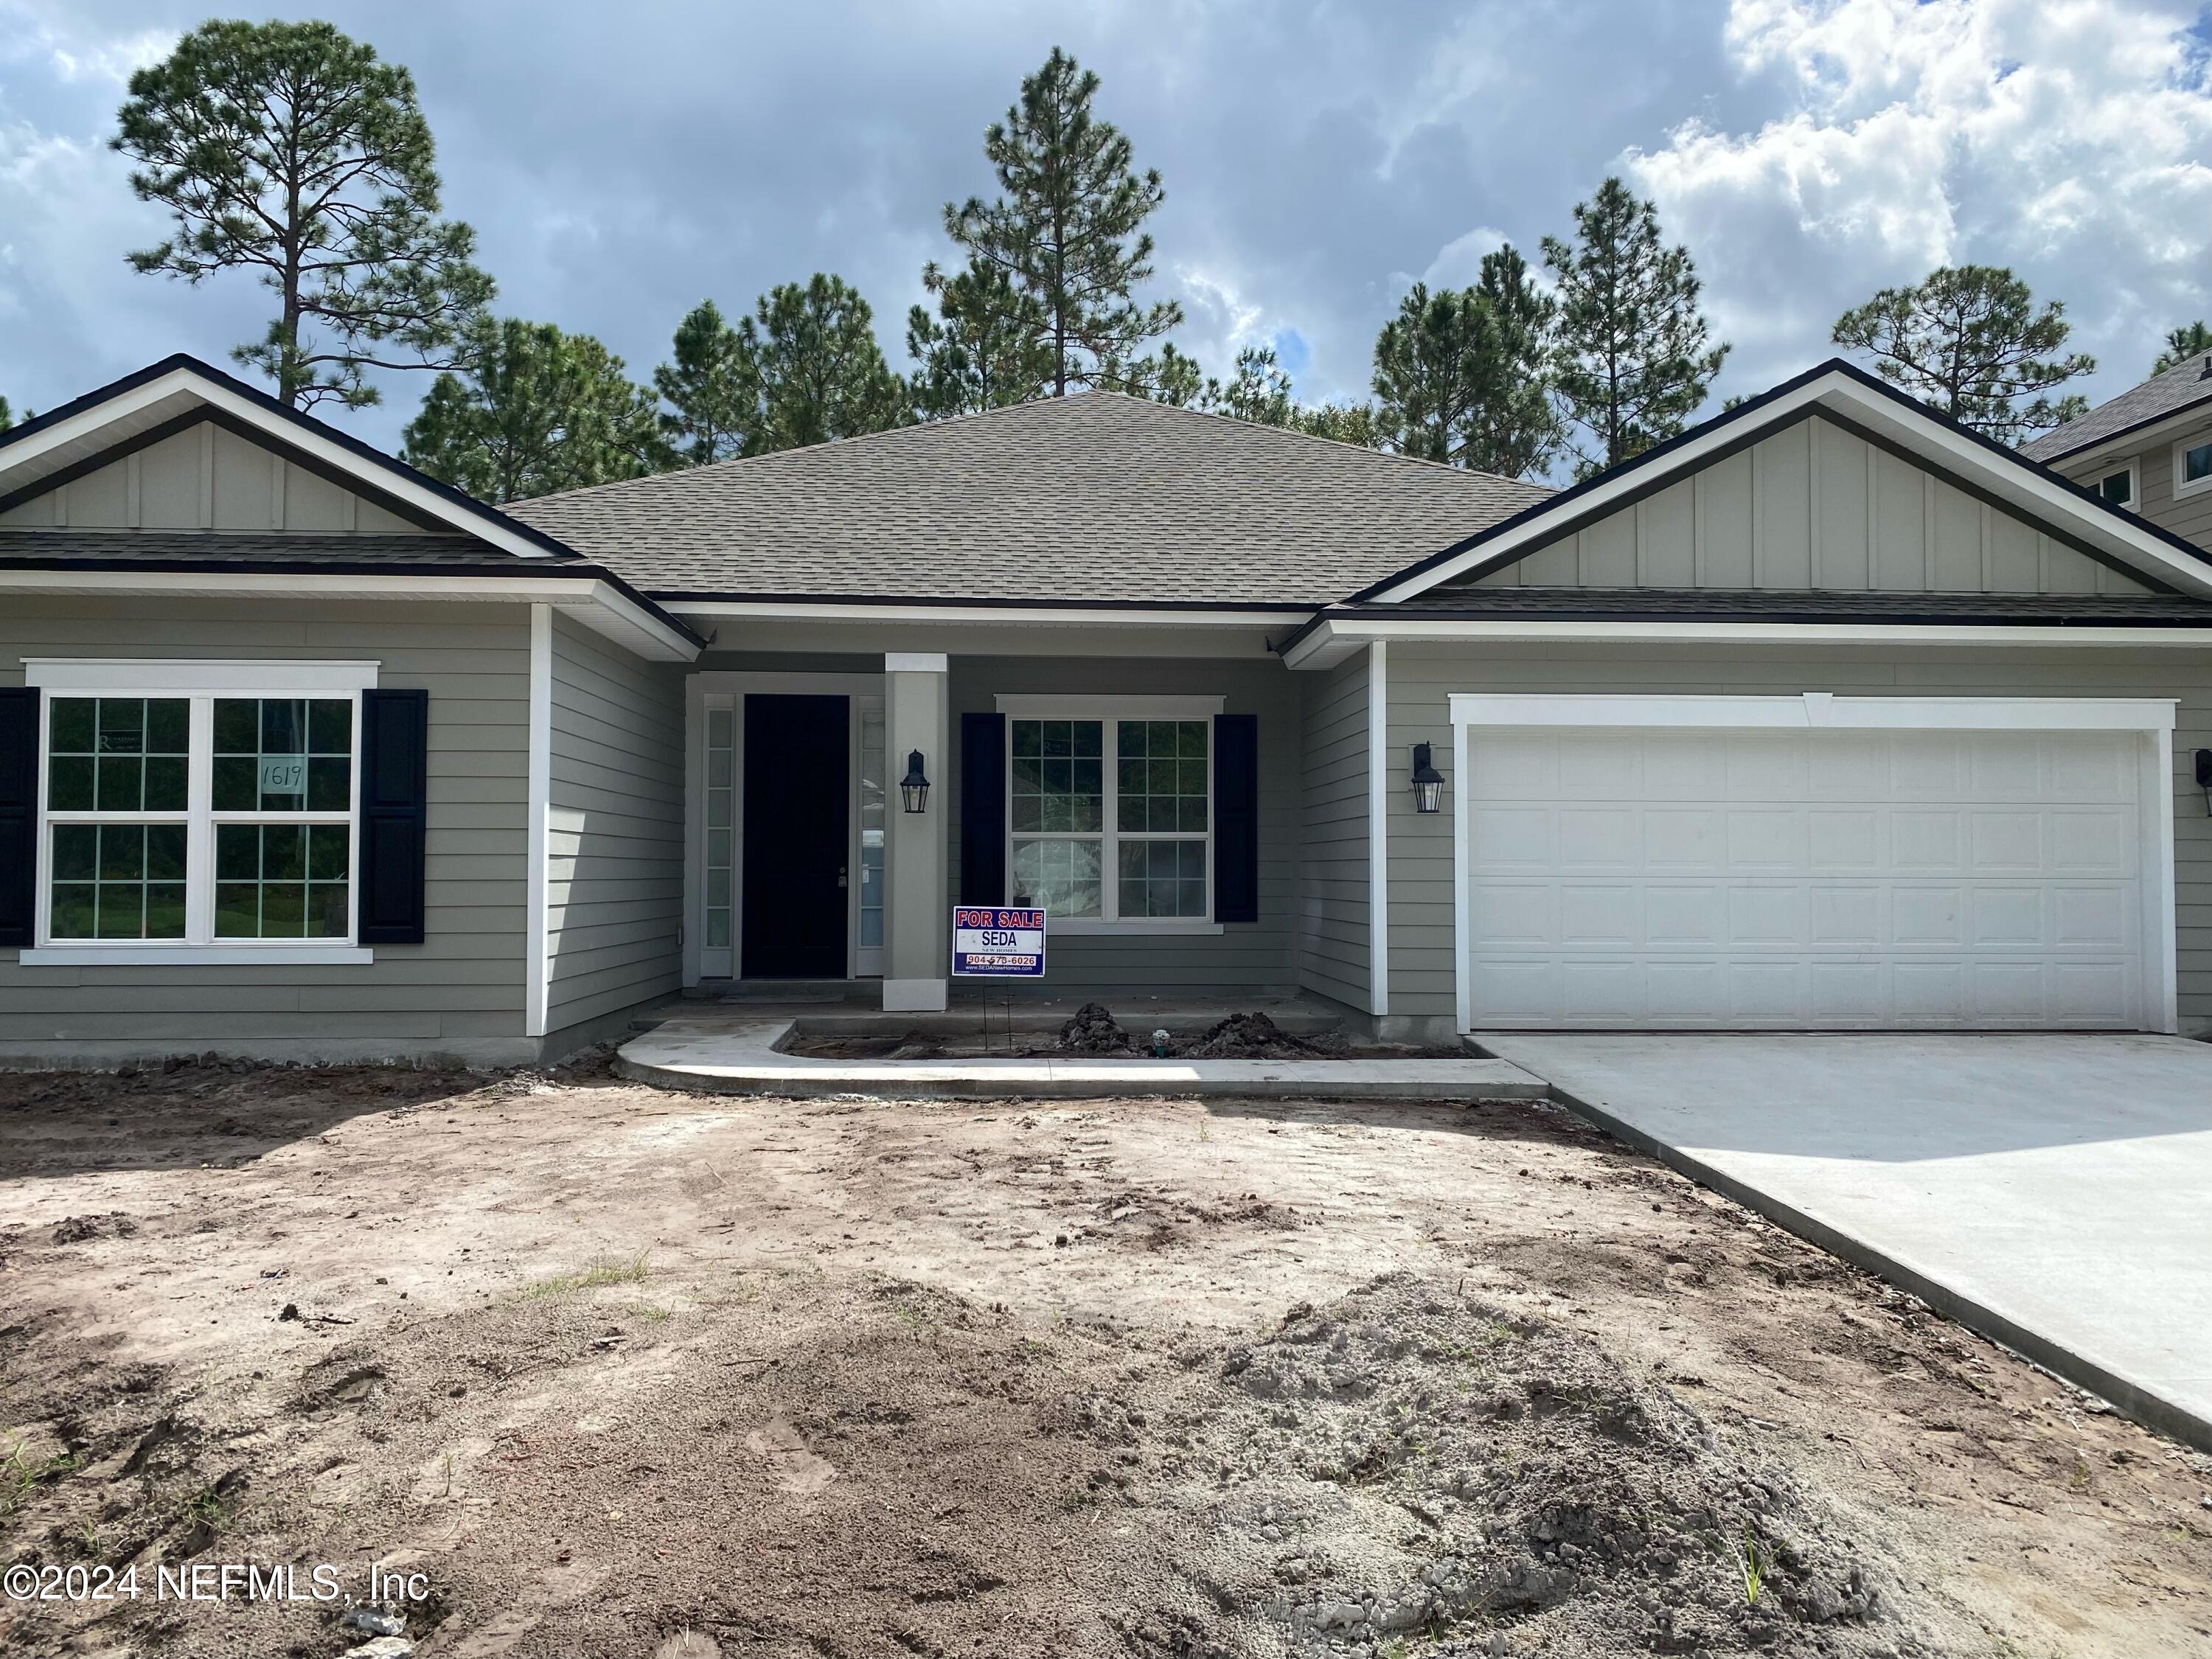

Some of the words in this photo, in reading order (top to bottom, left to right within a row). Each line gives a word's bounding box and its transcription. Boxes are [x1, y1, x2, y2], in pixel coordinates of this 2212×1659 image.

[264, 765, 302, 786] 1619
[957, 911, 993, 927] FOR
[998, 911, 1043, 928] SALE
[981, 931, 1017, 946] SEDA
